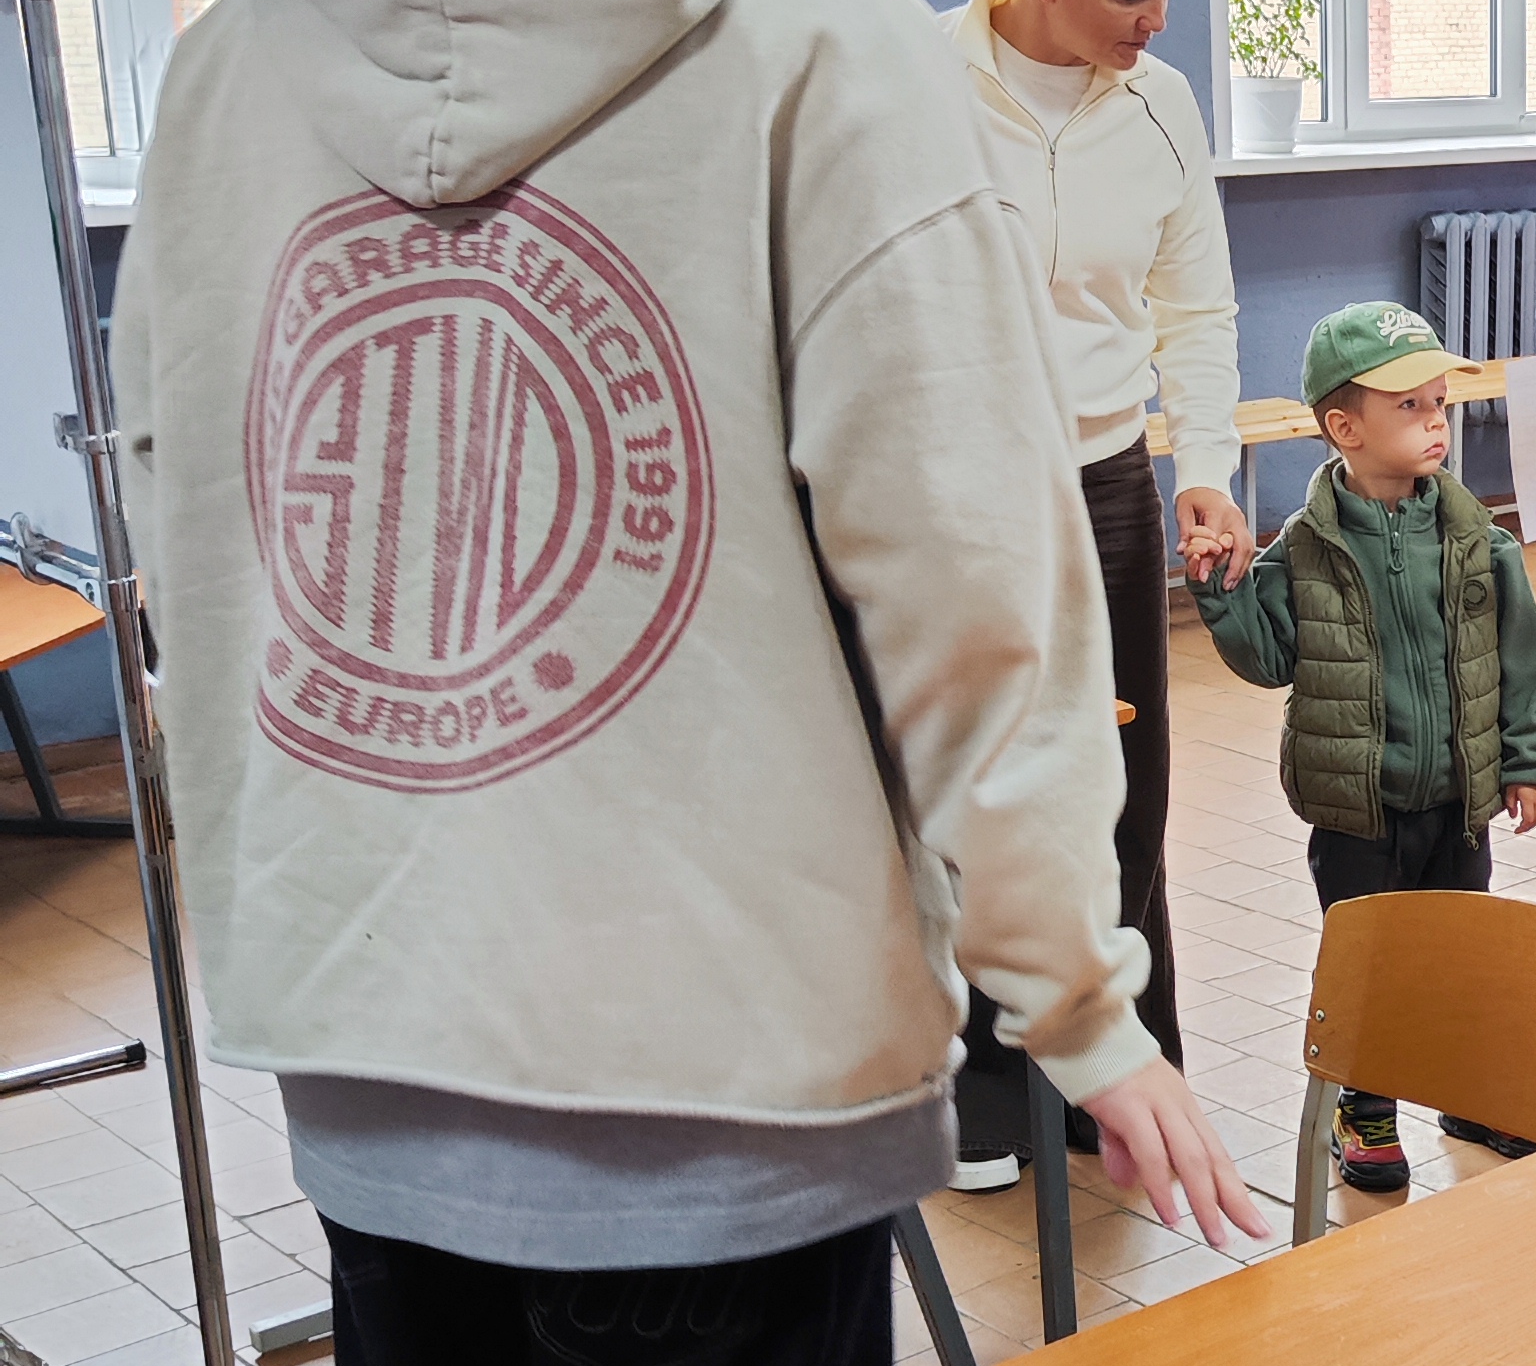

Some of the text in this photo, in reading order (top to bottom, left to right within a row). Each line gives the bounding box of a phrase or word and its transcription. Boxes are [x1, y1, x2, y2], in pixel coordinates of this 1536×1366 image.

[509, 239, 664, 416] SINCE
[613, 427, 677, 574] 1991
[291, 667, 530, 748] EUROPE
